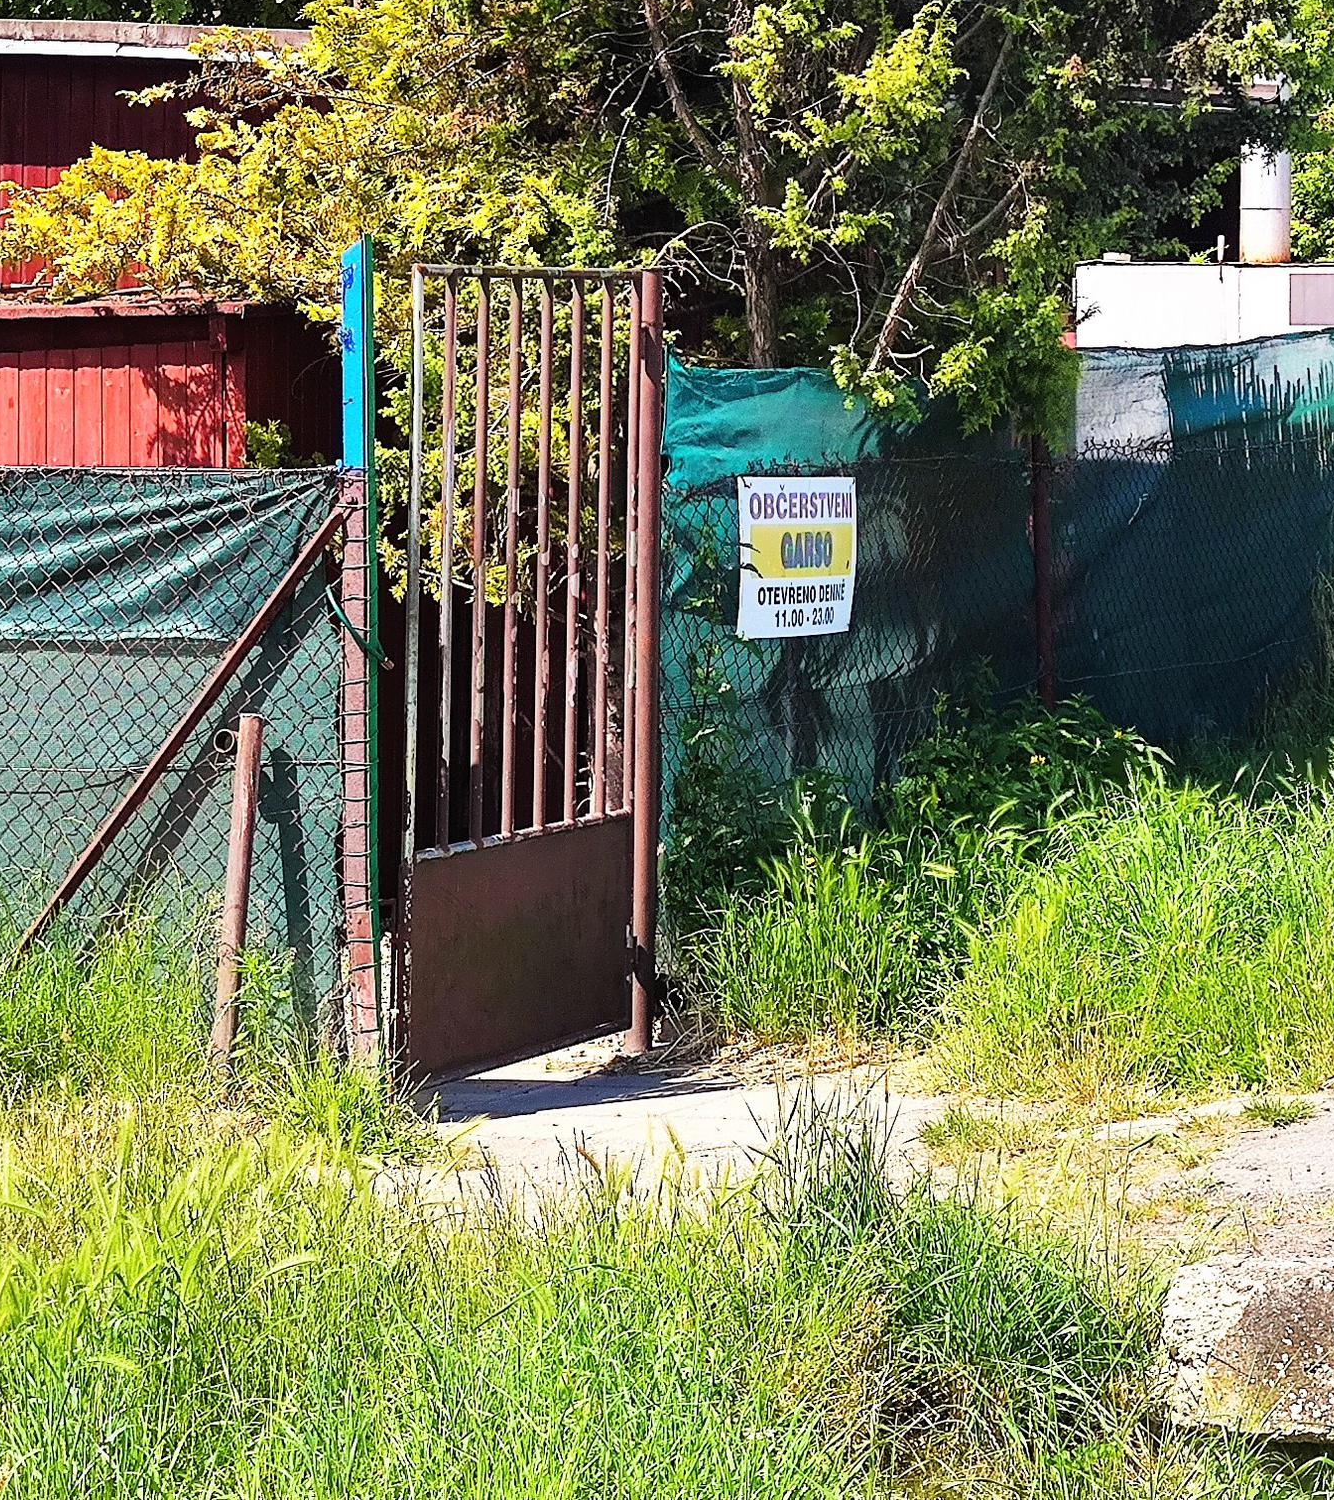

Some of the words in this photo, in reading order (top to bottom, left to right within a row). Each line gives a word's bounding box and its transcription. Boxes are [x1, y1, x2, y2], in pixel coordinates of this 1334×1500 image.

[749, 484, 853, 520] OBČERSTVENÍ
[758, 582, 816, 605] OTEVŘENO
[819, 579, 845, 602] DENNĚ
[775, 609, 804, 627] 11.00
[812, 607, 835, 626] 23.00
